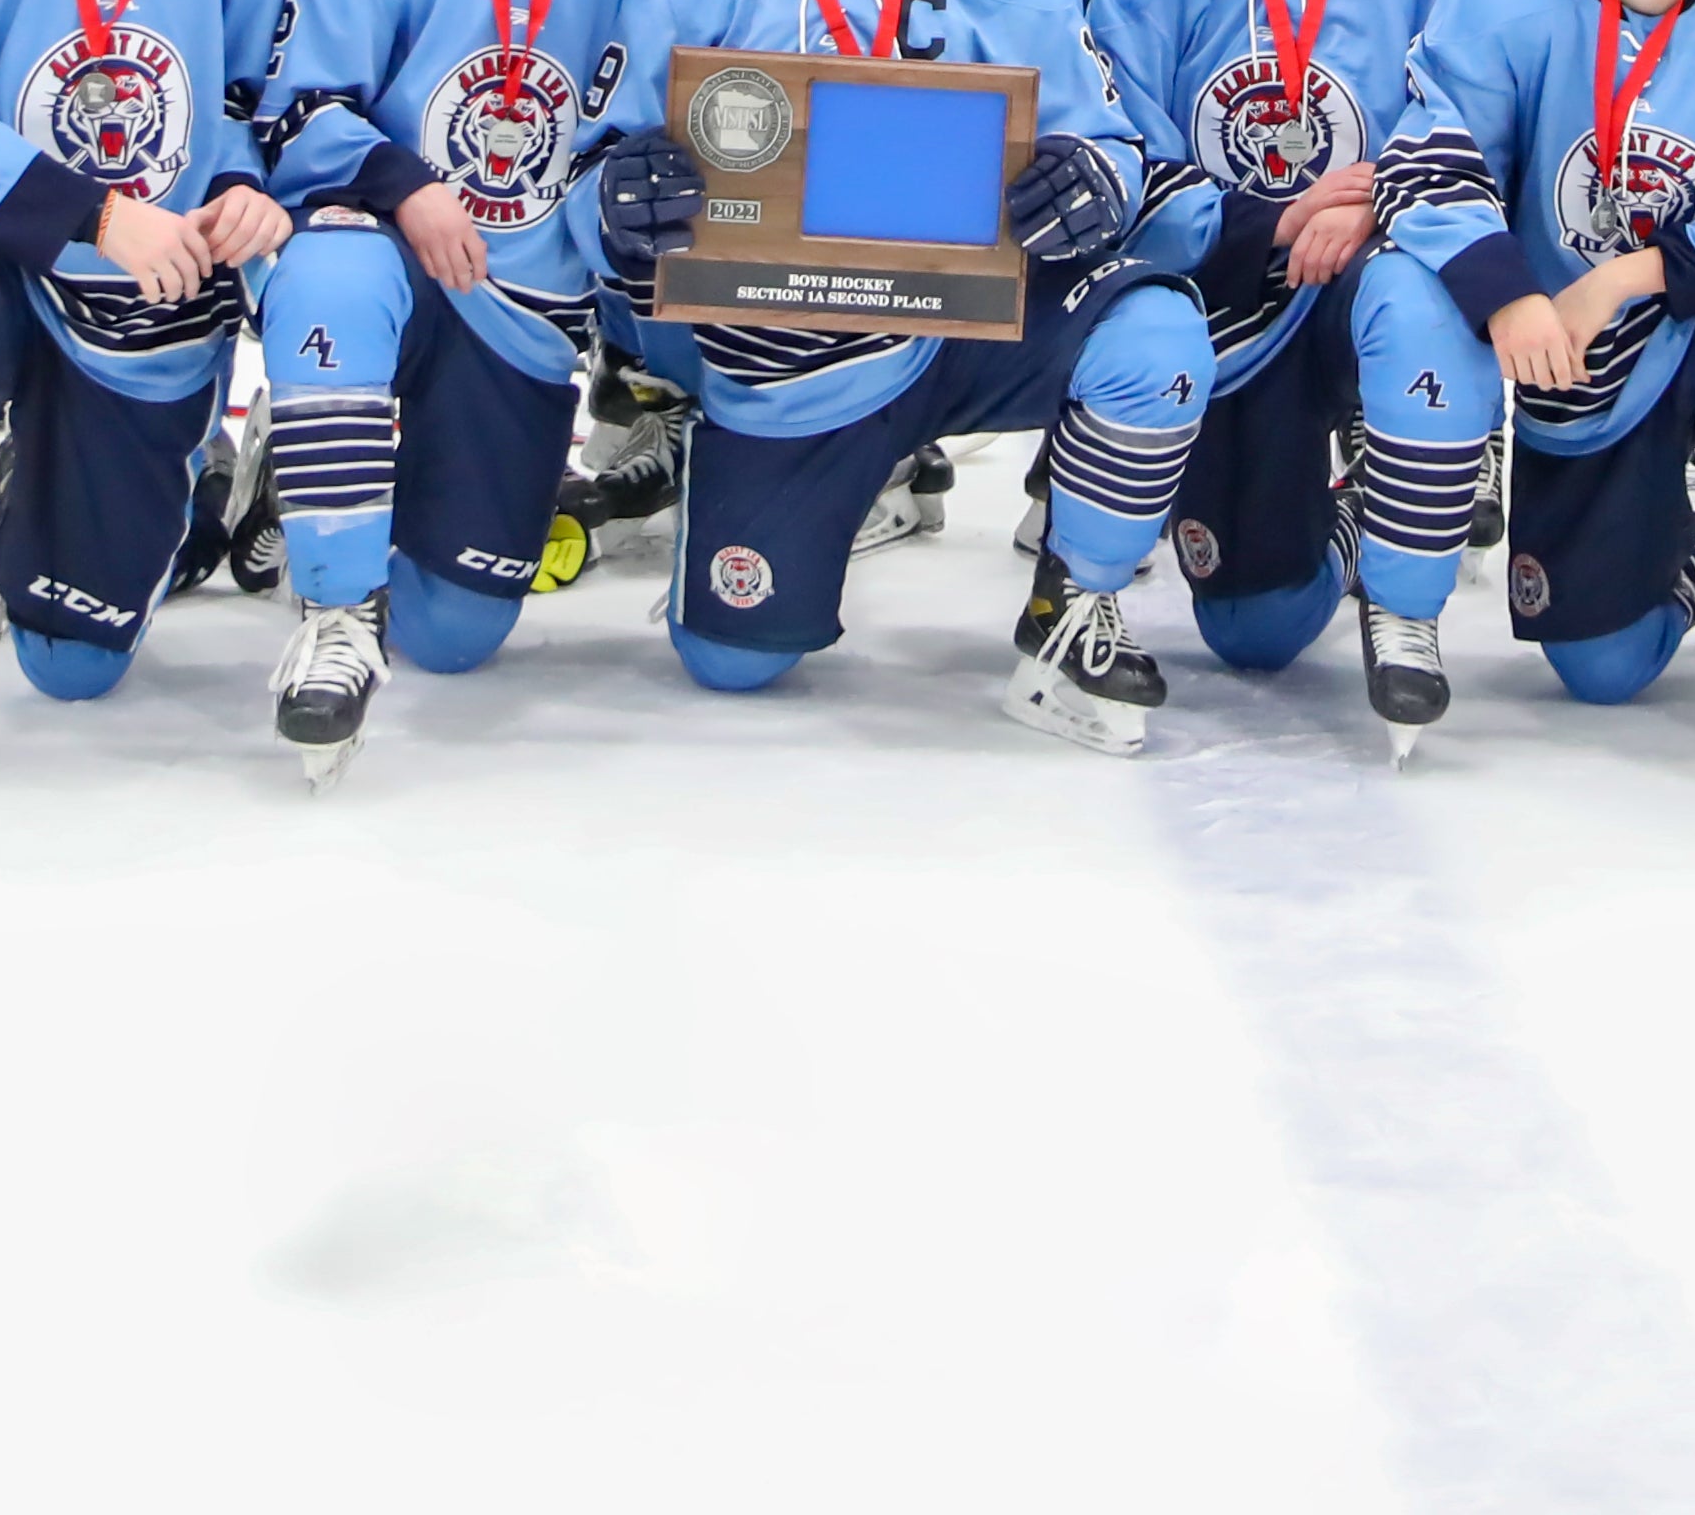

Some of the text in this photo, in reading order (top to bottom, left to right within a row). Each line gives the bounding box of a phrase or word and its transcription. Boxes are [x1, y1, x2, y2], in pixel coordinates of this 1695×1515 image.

[136, 36, 174, 83] LEA
[536, 67, 569, 108] LEA
[580, 41, 627, 122] 9
[458, 186, 527, 222] TIGERS
[713, 202, 756, 220] 2022
[737, 285, 942, 310] SECTION 1A SECOND PLACE
[788, 273, 895, 292] BOYS HOCKEY
[456, 546, 540, 580] CCM
[28, 574, 137, 628] CCM
